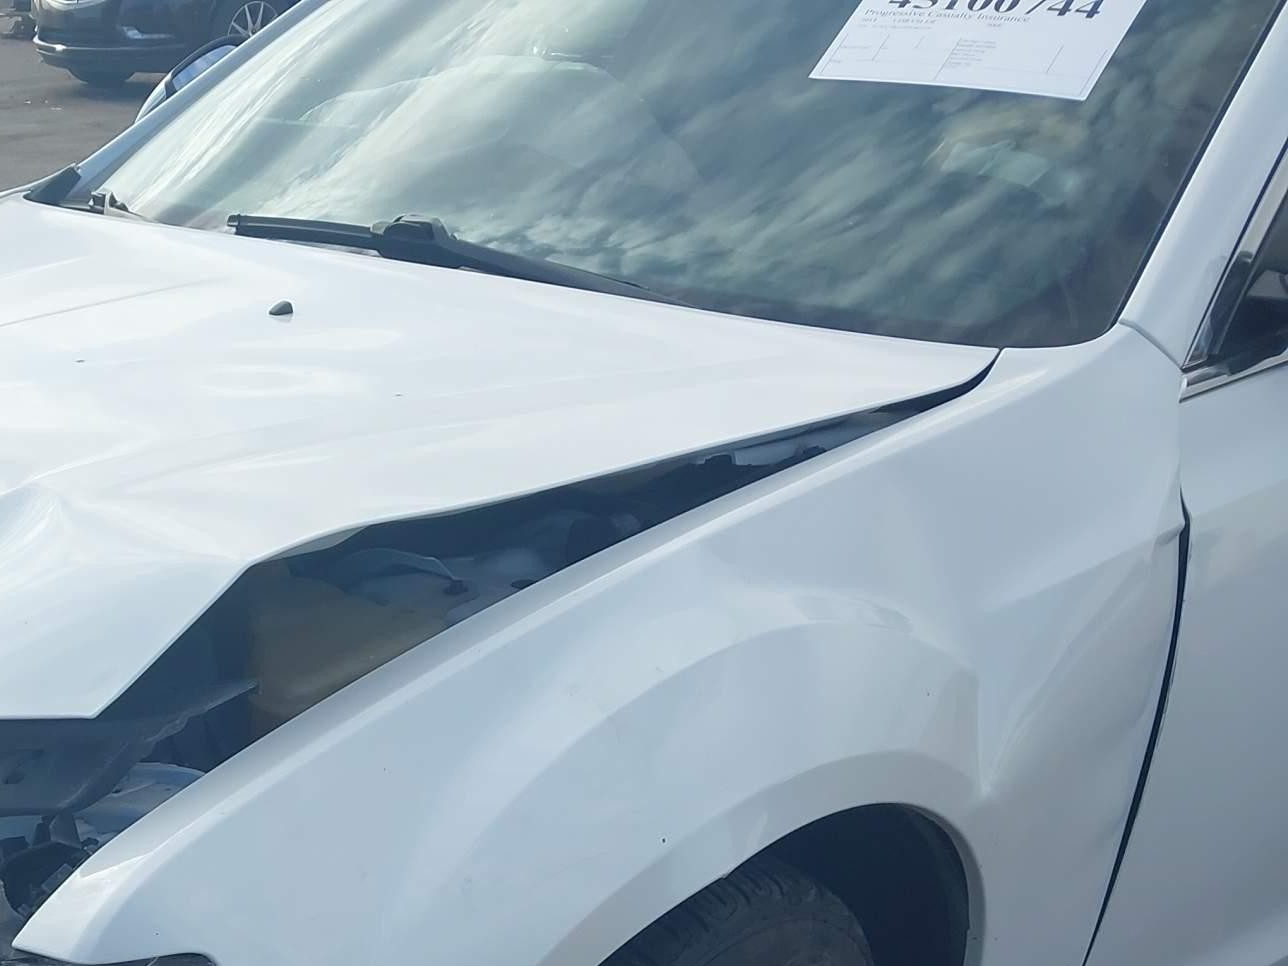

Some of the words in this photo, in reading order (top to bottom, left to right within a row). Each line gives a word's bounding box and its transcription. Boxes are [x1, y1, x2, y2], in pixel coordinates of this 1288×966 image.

[864, 8, 925, 18] Progressive
[927, 10, 972, 20] Casualty
[976, 13, 1031, 22] Insurance
